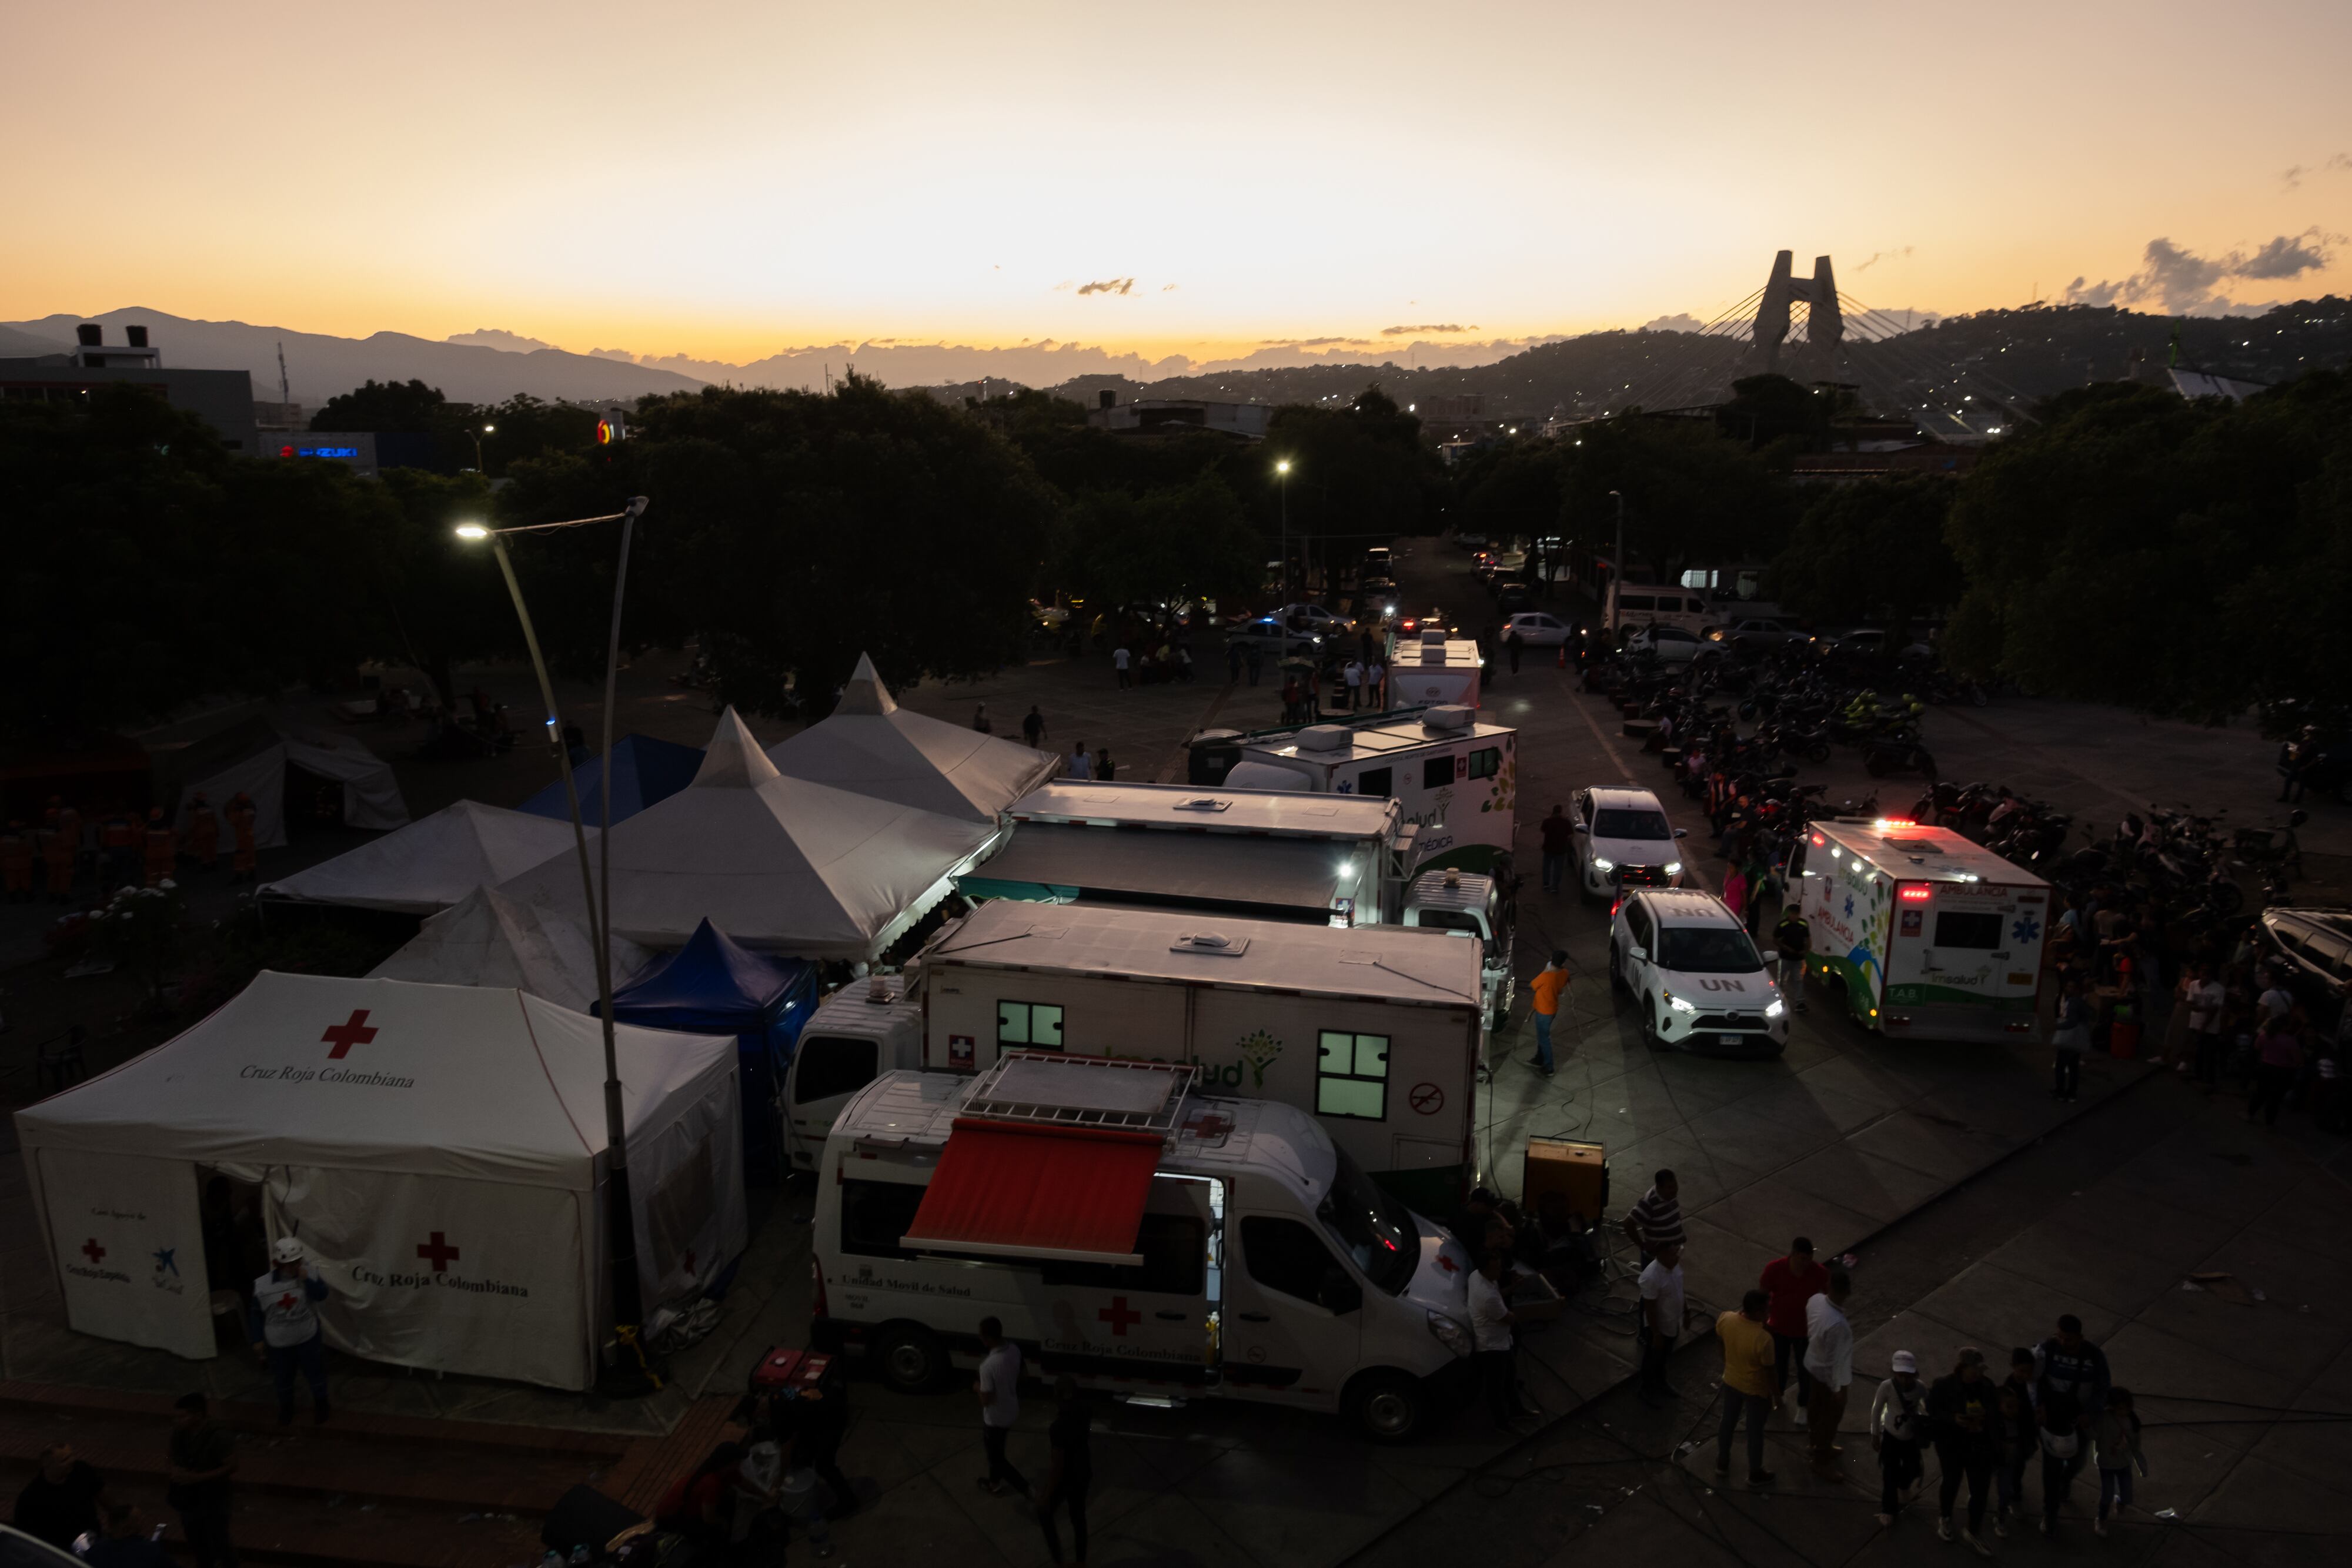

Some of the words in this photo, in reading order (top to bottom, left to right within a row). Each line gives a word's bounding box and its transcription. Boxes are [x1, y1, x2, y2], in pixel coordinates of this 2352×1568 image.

[299, 447, 358, 457] SUZUKI
[1940, 884, 2008, 897] AMBULANCIA
[1818, 906, 1854, 945] AMBULANCIA
[1699, 978, 1746, 992] UN
[239, 1064, 279, 1079] Cruz
[278, 1065, 316, 1084] Roja
[318, 1066, 415, 1088] Colombiana
[352, 1265, 385, 1287] Cruz
[389, 1271, 431, 1289] Roja
[435, 1272, 529, 1298] Colombiana
[843, 1274, 883, 1287] Unidad
[886, 1278, 920, 1291] Movil
[921, 1282, 936, 1293] de
[938, 1283, 971, 1297] Salud
[1044, 1337, 1078, 1351] Cruz
[1082, 1341, 1113, 1356] Roja
[1117, 1345, 1202, 1362] Colombiana
